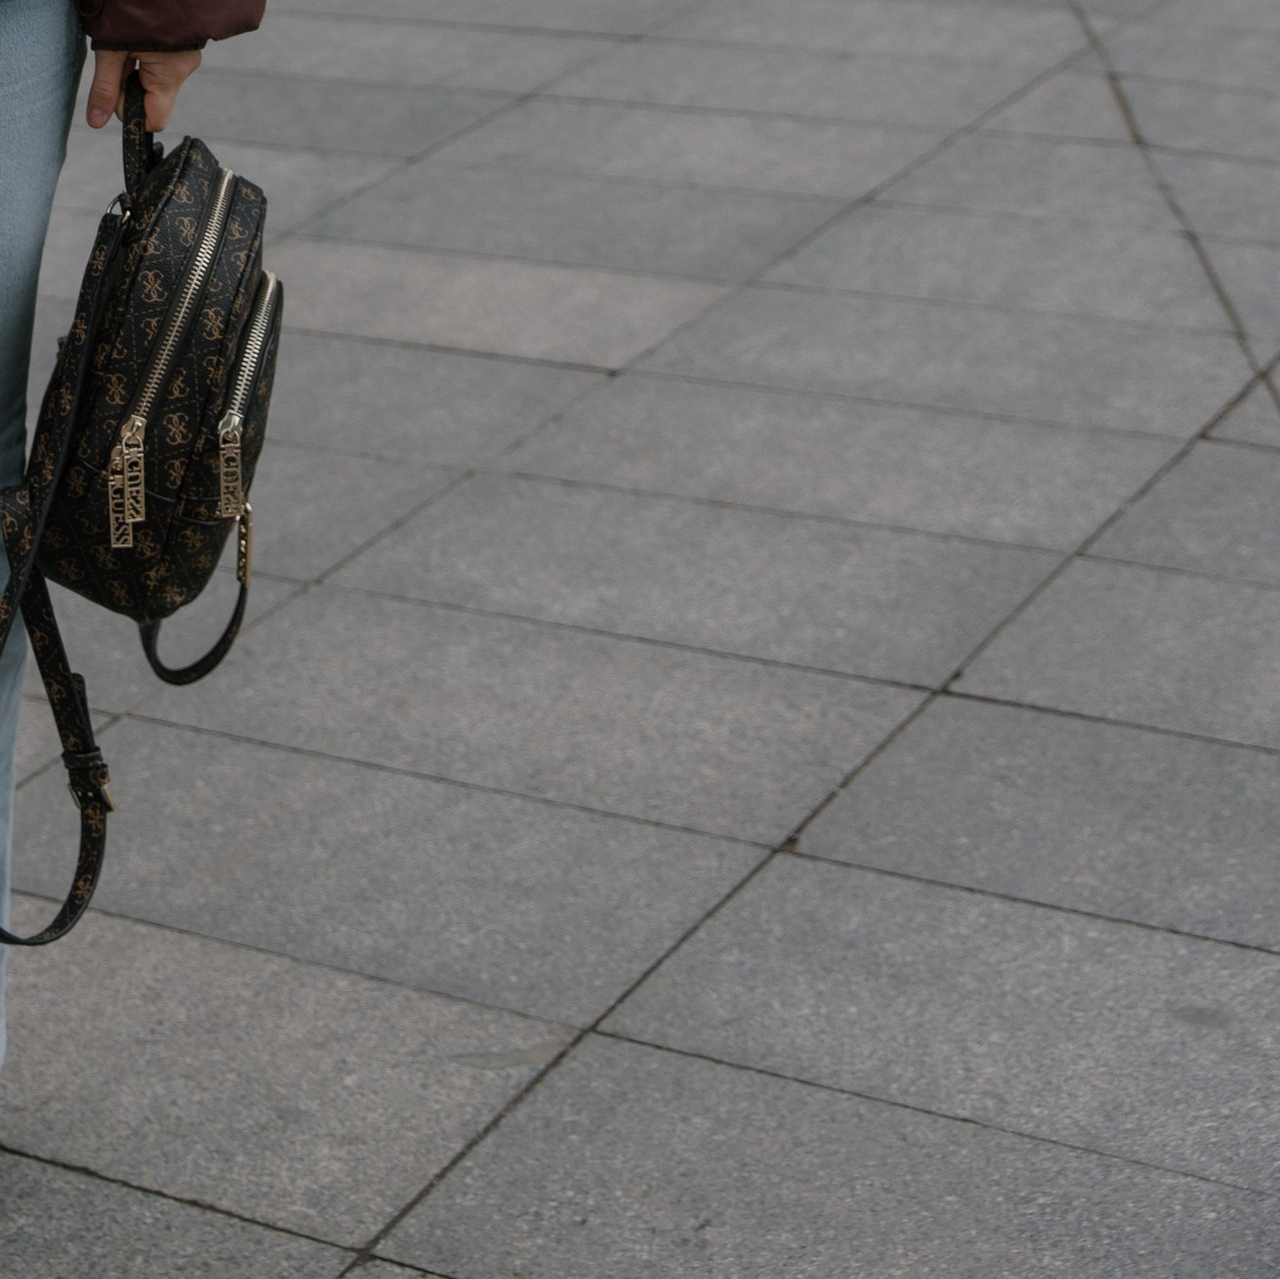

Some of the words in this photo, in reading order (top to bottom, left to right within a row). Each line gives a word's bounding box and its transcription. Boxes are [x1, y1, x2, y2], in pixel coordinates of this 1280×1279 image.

[126, 458, 143, 520] GUESS
[222, 453, 239, 513] GUESS
[112, 486, 130, 545] GUESS
